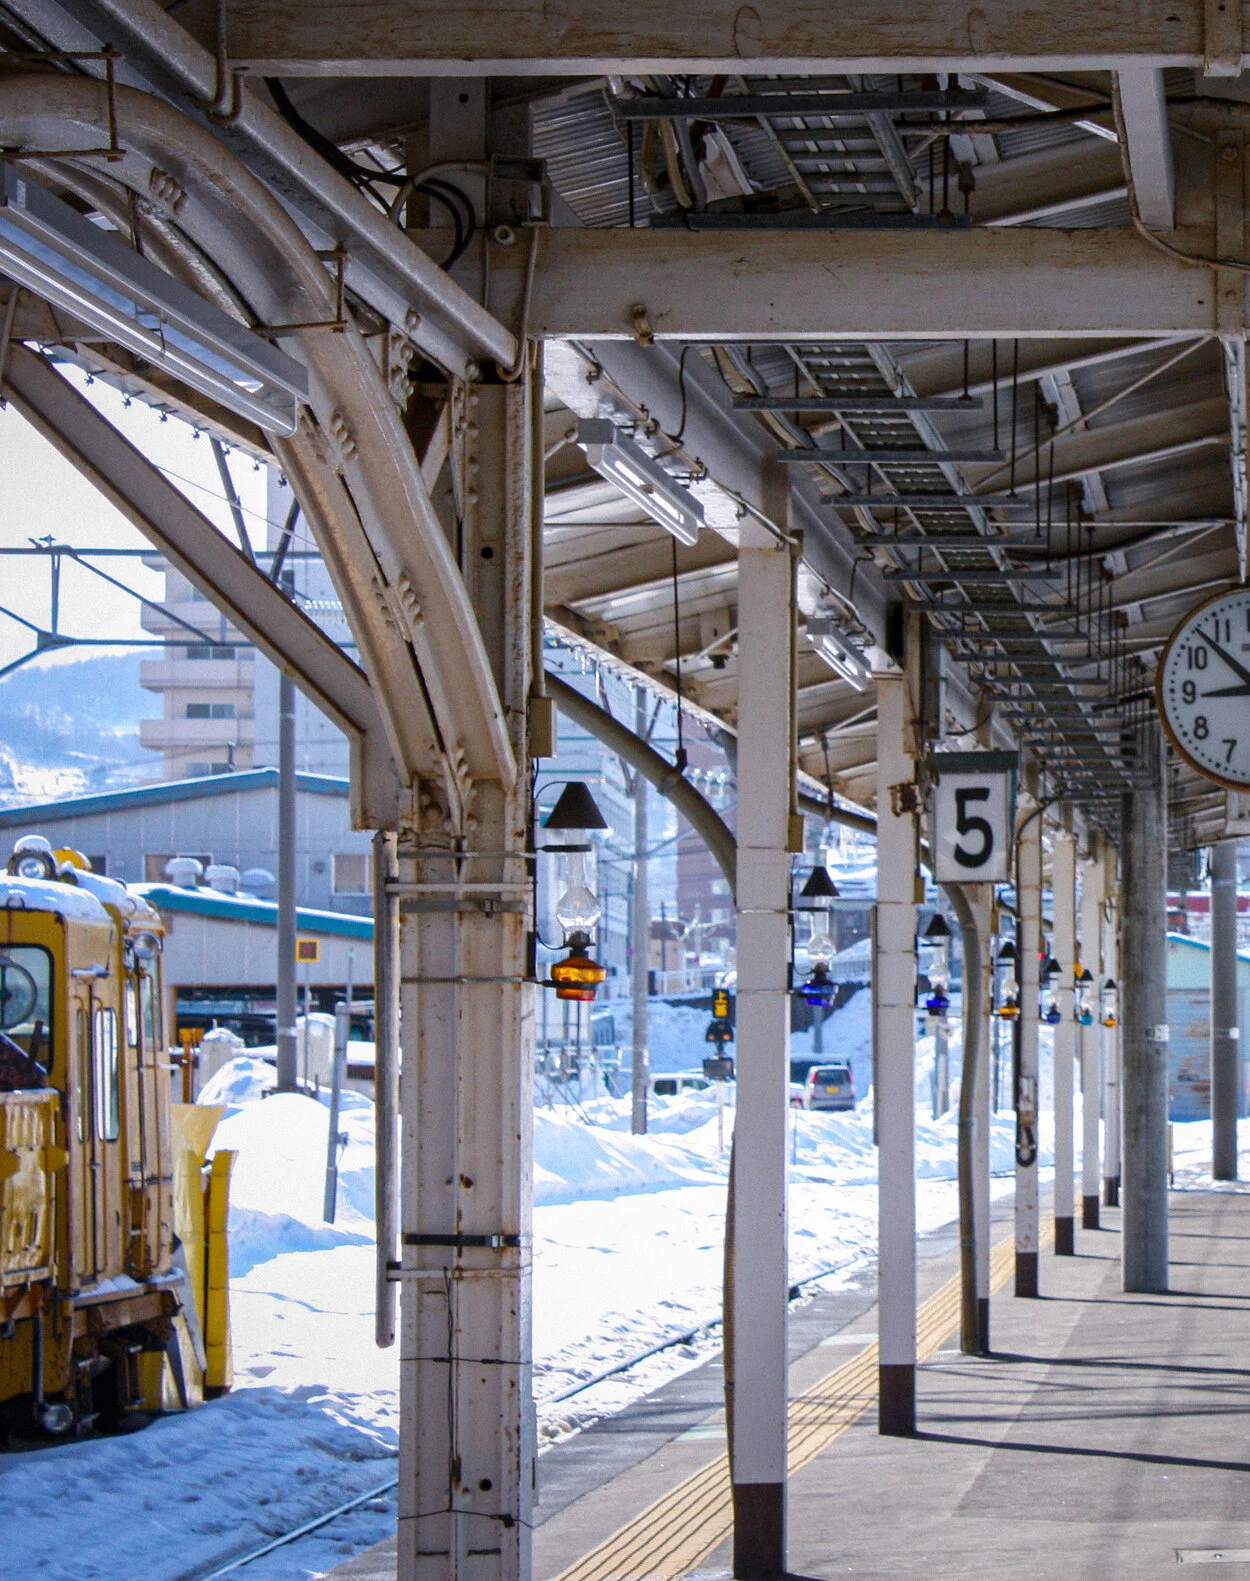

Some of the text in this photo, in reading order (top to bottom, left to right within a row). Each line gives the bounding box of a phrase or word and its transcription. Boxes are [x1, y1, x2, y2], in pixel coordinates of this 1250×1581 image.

[1215, 618, 1230, 642] 11
[1187, 646, 1207, 670] 10
[1182, 680, 1196, 704] 9
[1193, 716, 1209, 739] 8
[1222, 739, 1237, 763] 7
[954, 788, 993, 868] 5
